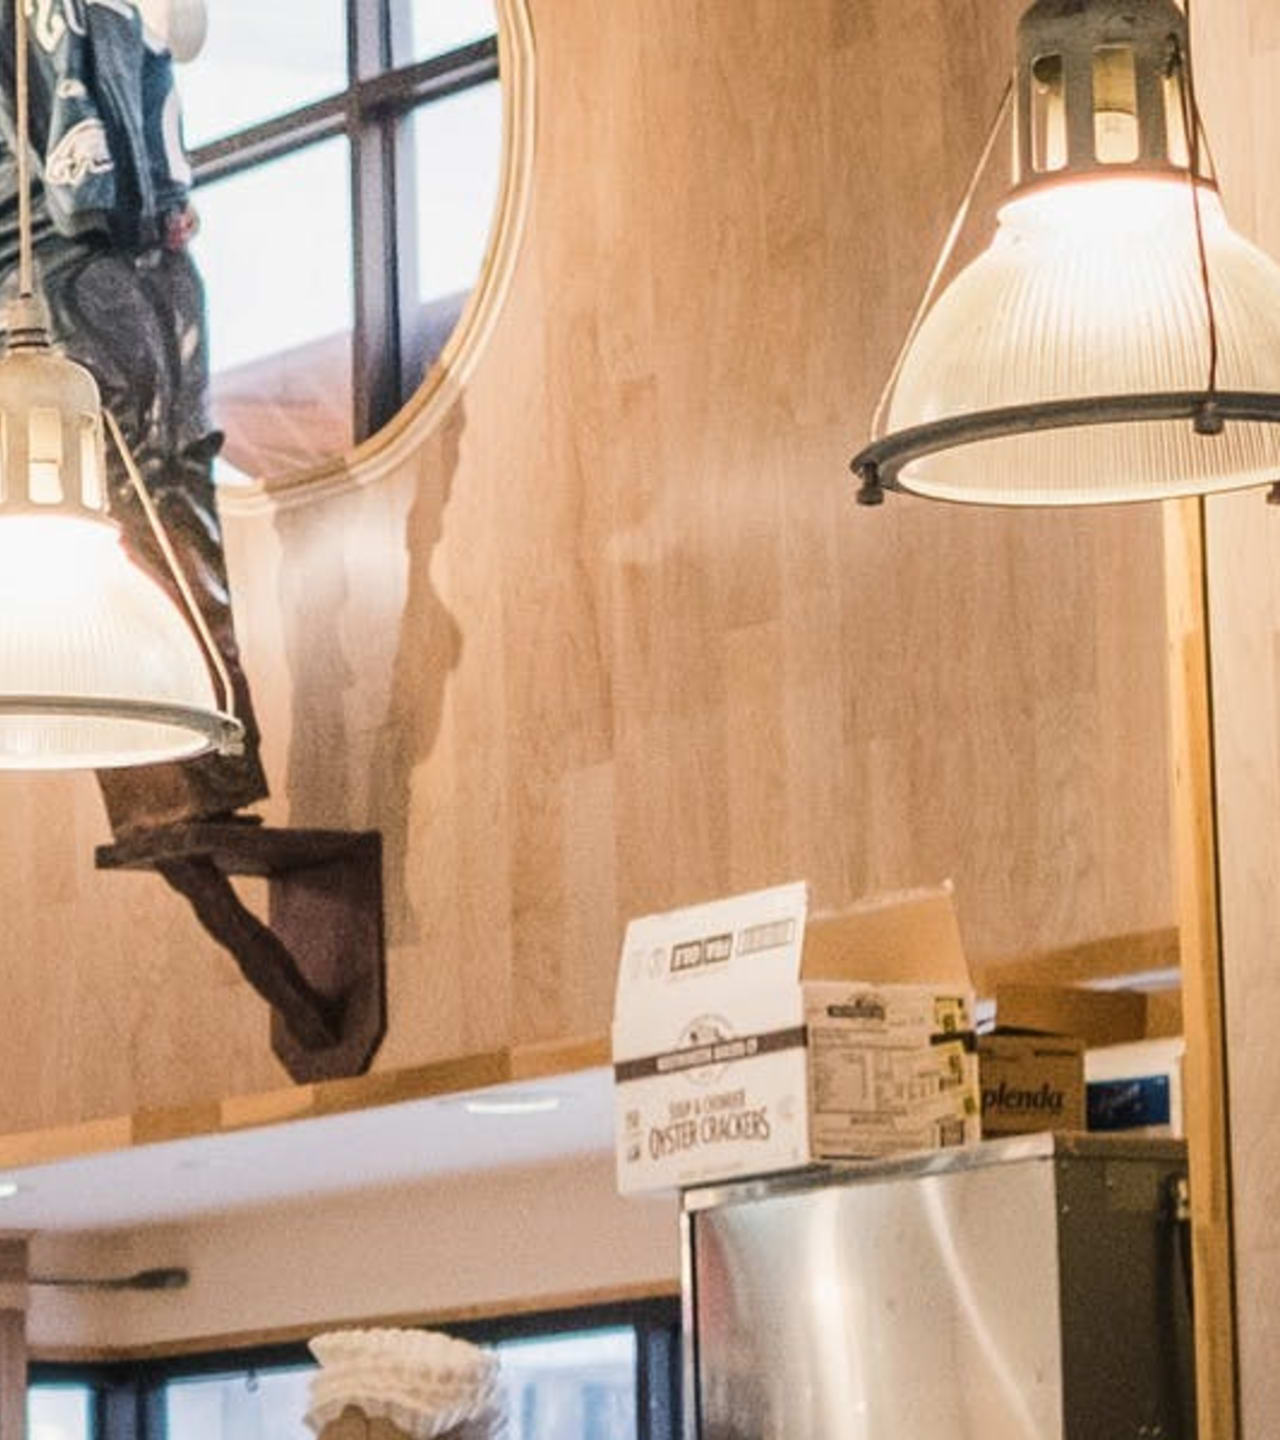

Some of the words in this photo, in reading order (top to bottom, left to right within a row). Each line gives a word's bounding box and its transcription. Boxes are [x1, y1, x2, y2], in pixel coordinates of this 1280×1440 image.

[980, 1082, 1064, 1114] plenda
[648, 1118, 698, 1161] OYSTER
[700, 1104, 771, 1147] CRACKERS
